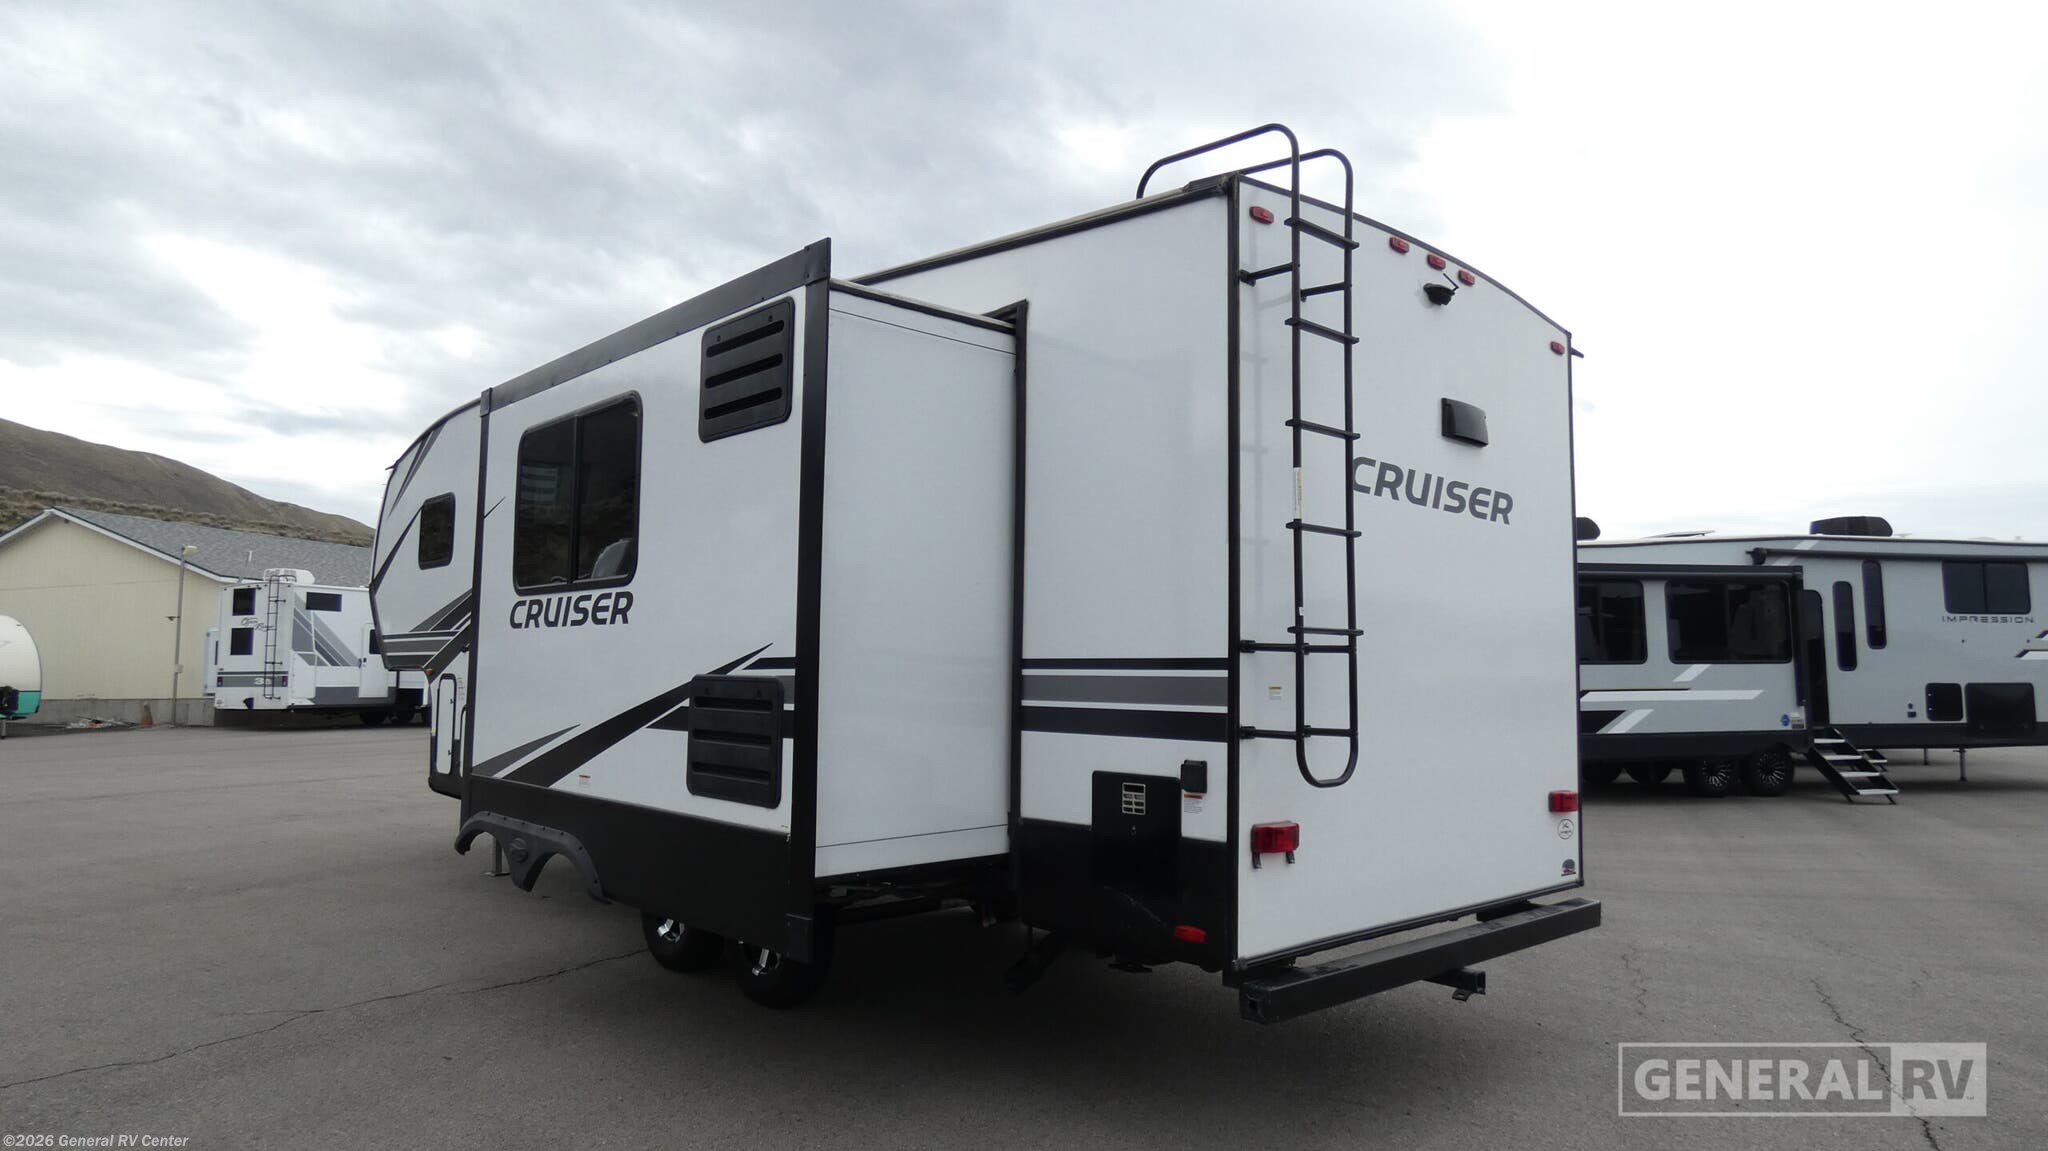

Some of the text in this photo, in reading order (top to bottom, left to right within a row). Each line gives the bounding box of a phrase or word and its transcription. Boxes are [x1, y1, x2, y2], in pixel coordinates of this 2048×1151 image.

[1352, 456, 1514, 525] CRUISER
[509, 591, 634, 629] CRUISER
[1942, 615, 2034, 624] IMPRESSION
